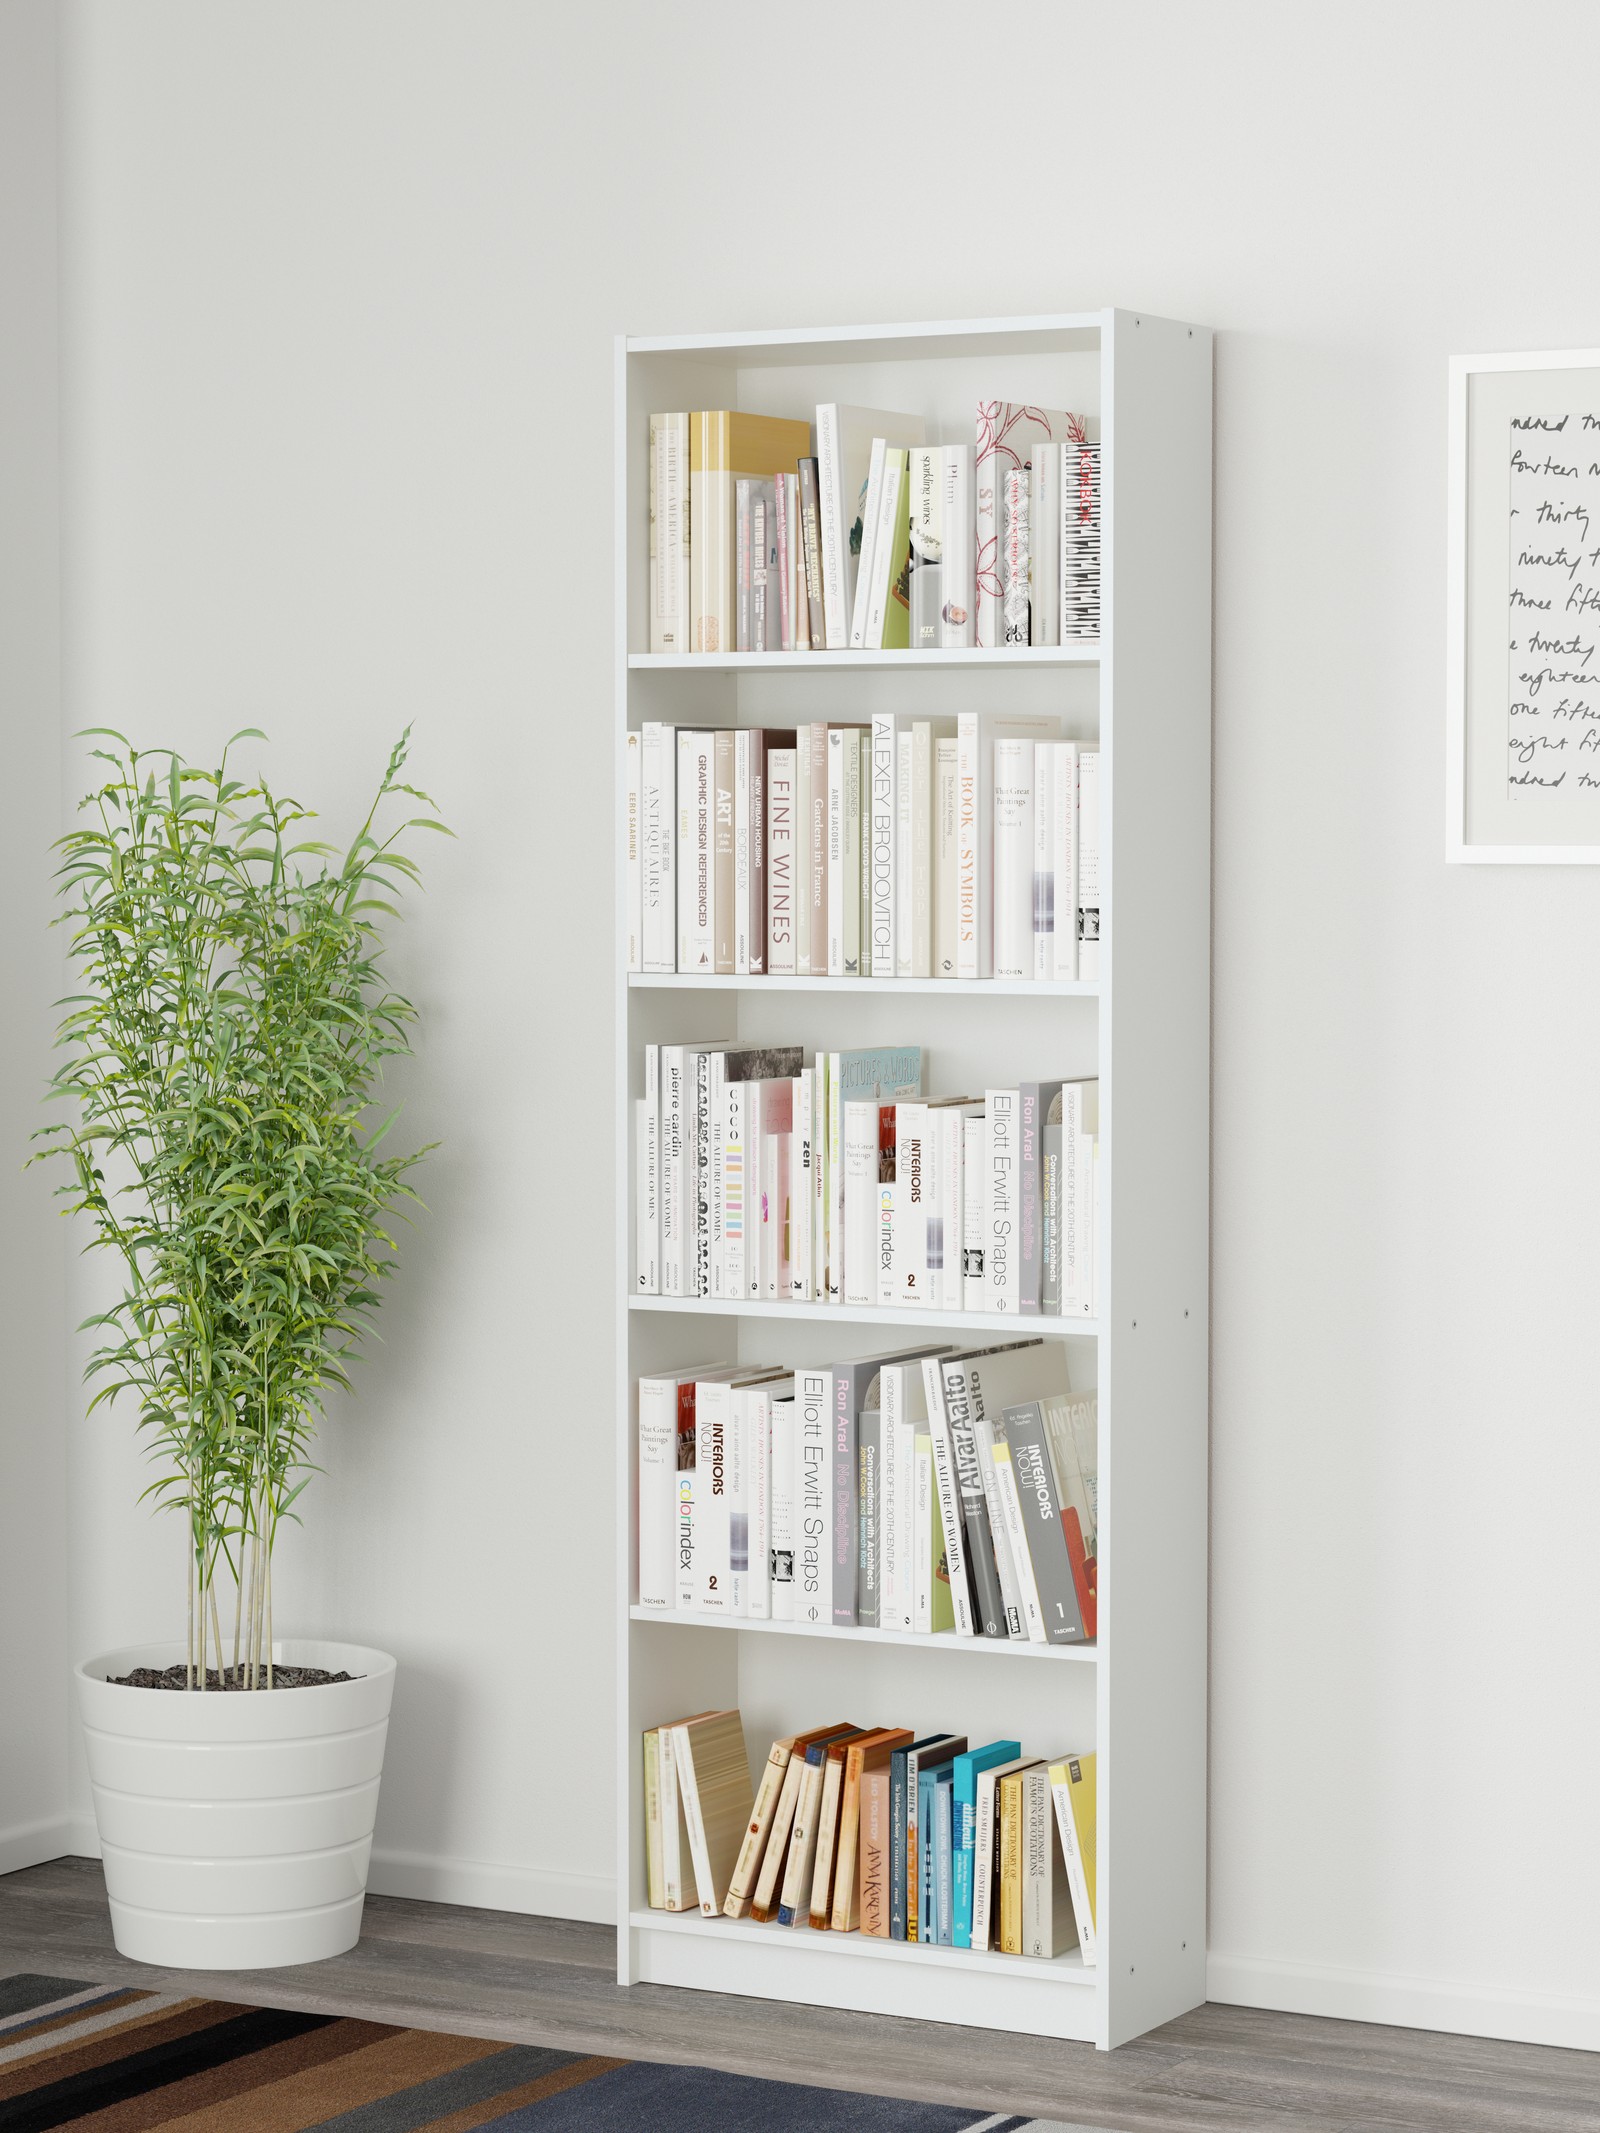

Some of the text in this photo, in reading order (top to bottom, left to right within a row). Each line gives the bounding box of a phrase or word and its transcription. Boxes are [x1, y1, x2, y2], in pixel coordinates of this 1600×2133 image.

[668, 447, 680, 482] BIRTH
[946, 464, 958, 504] Plum
[1079, 450, 1092, 526] KOKBOK
[1511, 449, 1578, 478] fourteen
[755, 504, 764, 516] THE
[920, 456, 932, 525] sparkling wines
[668, 496, 680, 548] AMERICA
[780, 516, 786, 525] of
[808, 523, 817, 550] BRAVE
[1536, 501, 1589, 542] thirty
[755, 546, 764, 568] RIFLES
[1518, 545, 1582, 580] ninety
[1510, 588, 1552, 610] three
[1528, 631, 1595, 667] twenty
[1510, 703, 1540, 715] one
[1509, 735, 1569, 763] eight
[850, 742, 858, 818] TEXTILE DESIGNERS
[960, 776, 973, 829] BOOK
[628, 792, 636, 860] EERO SAARINEN
[717, 788, 732, 826] ART
[946, 810, 954, 836] Knitting
[646, 786, 660, 908] ANTIQUAIRES
[662, 830, 670, 872] THE BIKE BOOK
[698, 754, 707, 927] GRAPHIC DESIGN REFERENCED
[738, 828, 747, 890] BORDEAUX
[773, 781, 790, 944] FINE WINES
[814, 798, 824, 906] Gardens in France
[874, 721, 891, 958] ALEXEY BRODOVITCH
[960, 849, 973, 942] SYMBOLS
[671, 1068, 682, 1157] pierre cardin
[901, 1138, 910, 1174] NOW!
[911, 1139, 921, 1202] INTERIORS
[648, 1180, 655, 1195] OF
[990, 1096, 1011, 1286] Elliott Erwitt Snaps
[881, 1191, 894, 1270] colorindex
[908, 1274, 915, 1287] 2
[701, 1422, 712, 1462] NOW!
[946, 1374, 980, 1489] Alvar Aalto
[713, 1423, 723, 1496] INTERIORS
[800, 1377, 824, 1592] Elliott Erwitt Snaps
[835, 1380, 849, 1564] Ron Arad No Discipline
[886, 1374, 894, 1574] VISIONARY ARCHITECTURE OF THE 20TH CENTURY
[919, 1459, 927, 1511] Italian Design
[1016, 1446, 1034, 1489] NOW!
[1028, 1444, 1053, 1520] INTERIORS
[680, 1480, 695, 1570] colorindex
[867, 1446, 875, 1589] Conversations with Architects
[935, 1437, 960, 1573] THE ALLURE OF WOMEN
[709, 1576, 717, 1590] 2
[958, 1599, 966, 1629] ASSOULINE
[1009, 1608, 1019, 1633] MoMA
[1056, 1603, 1064, 1618] 1
[954, 1801, 963, 1851] CONVERSATIONS
[962, 1803, 974, 1849] difficult
[980, 1796, 989, 1852] FRED SMEIJERS
[1058, 1790, 1075, 1856] American Design
[977, 1864, 985, 1926] COUNTERPUNCH
[1037, 1866, 1044, 1877] OF
